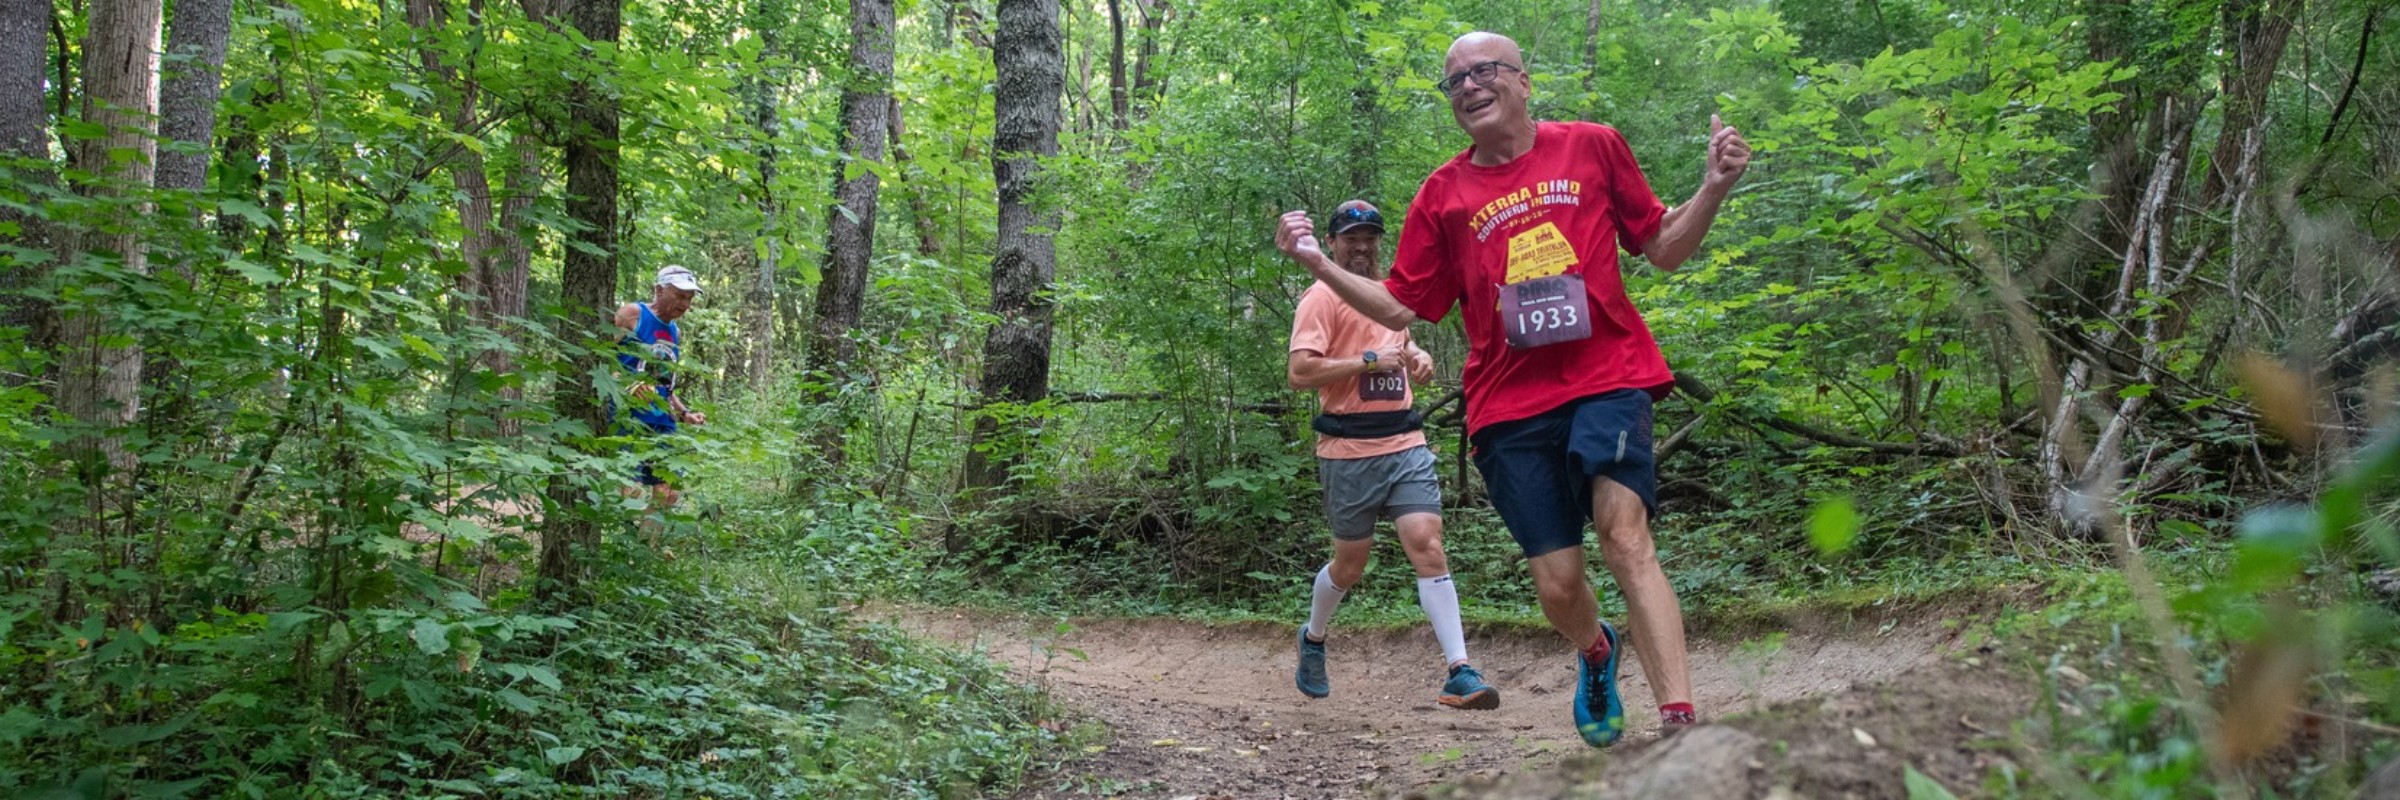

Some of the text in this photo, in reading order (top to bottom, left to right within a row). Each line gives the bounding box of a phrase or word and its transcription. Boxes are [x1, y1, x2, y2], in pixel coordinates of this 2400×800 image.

[1469, 180, 1580, 232] XTERRA DINO
[1477, 202, 1529, 242] SOUTHERN
[1531, 194, 1579, 206] INDIANA
[1518, 305, 1577, 334] 1933
[1370, 376, 1403, 391] 1902
